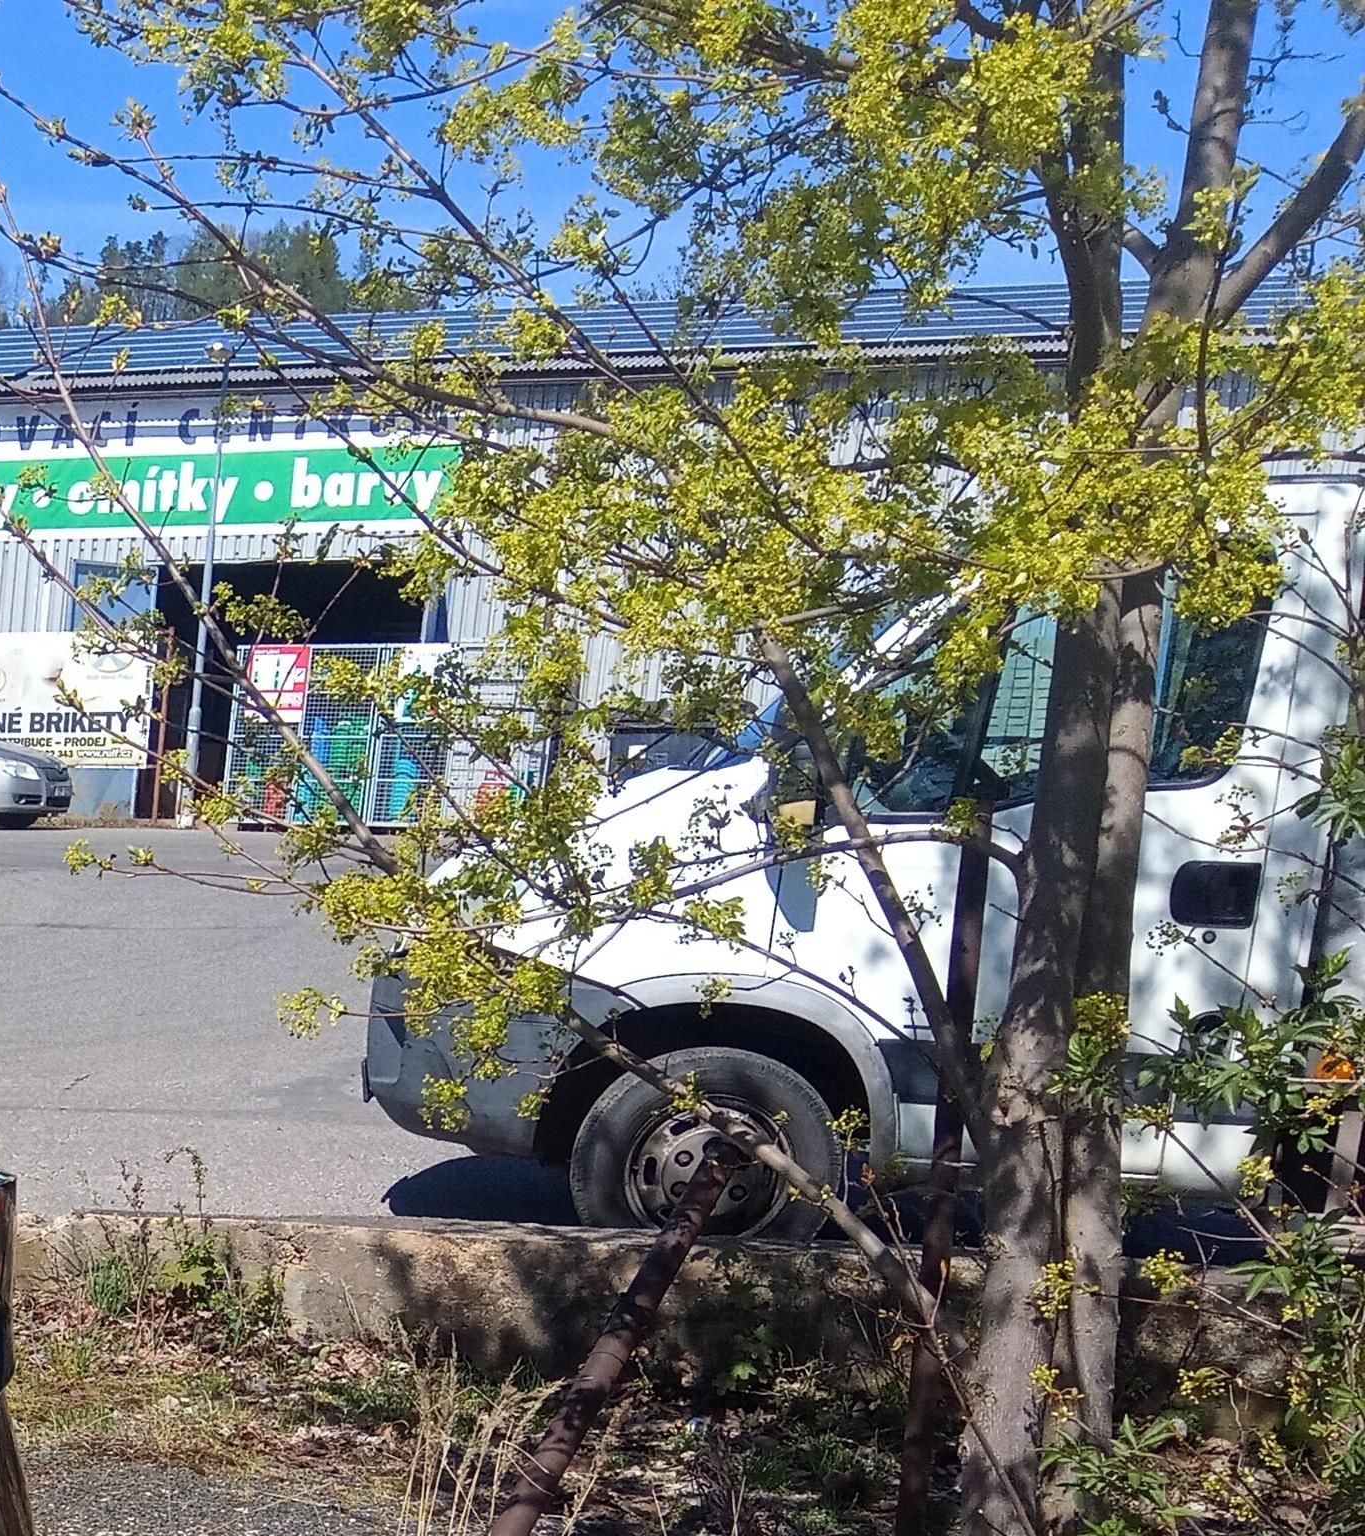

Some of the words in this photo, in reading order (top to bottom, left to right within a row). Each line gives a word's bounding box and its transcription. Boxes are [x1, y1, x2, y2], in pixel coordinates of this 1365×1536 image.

[68, 461, 239, 524] omítky
[290, 457, 444, 518] barvy
[64, 736, 107, 747] PRODEJ
